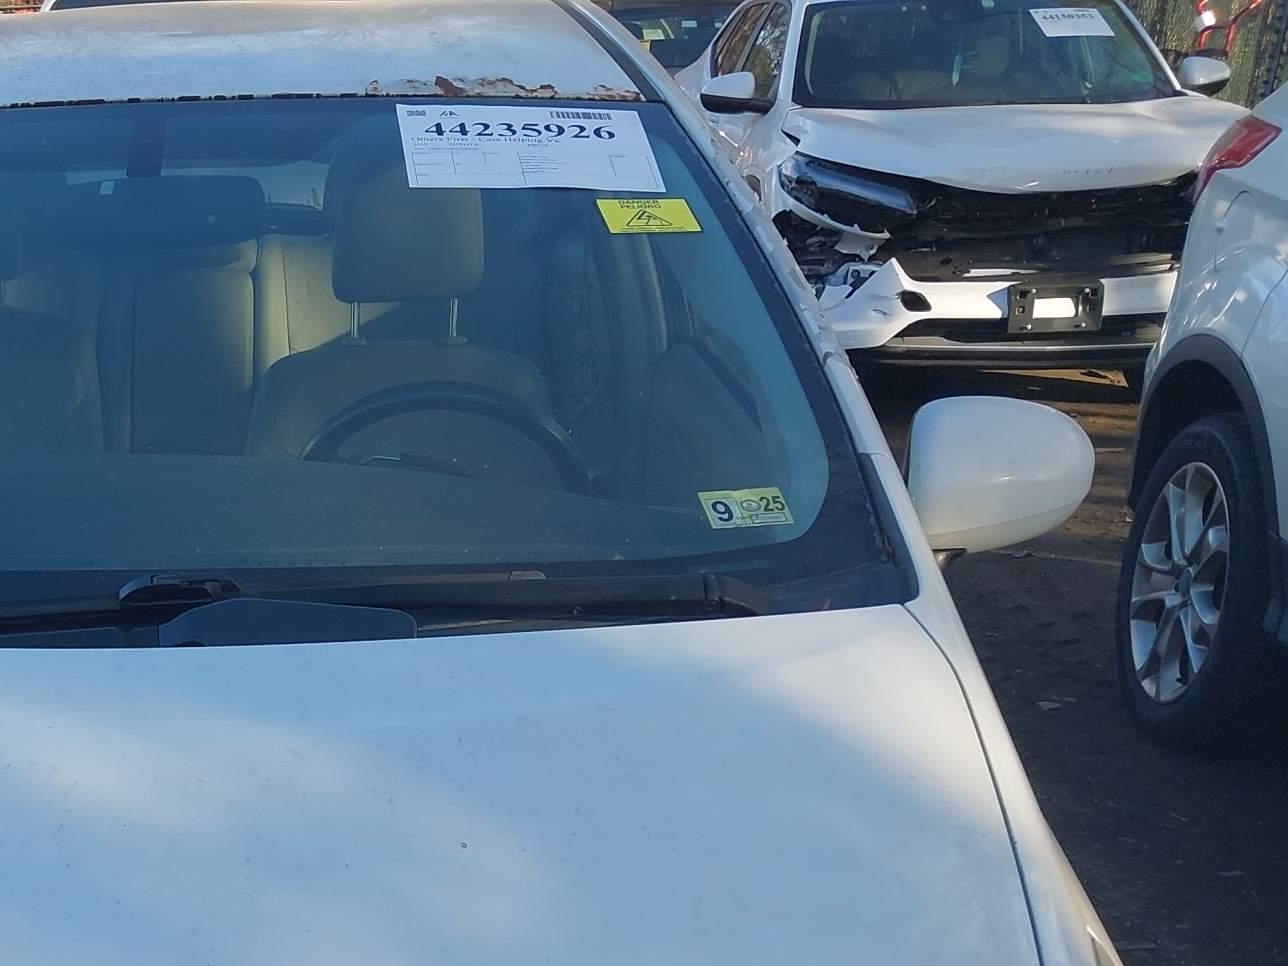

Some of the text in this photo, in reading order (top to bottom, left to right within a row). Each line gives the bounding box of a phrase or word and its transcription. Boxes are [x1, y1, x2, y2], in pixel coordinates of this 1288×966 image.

[424, 121, 616, 140] 44235926
[711, 500, 734, 523] 9
[759, 495, 786, 512] 25
